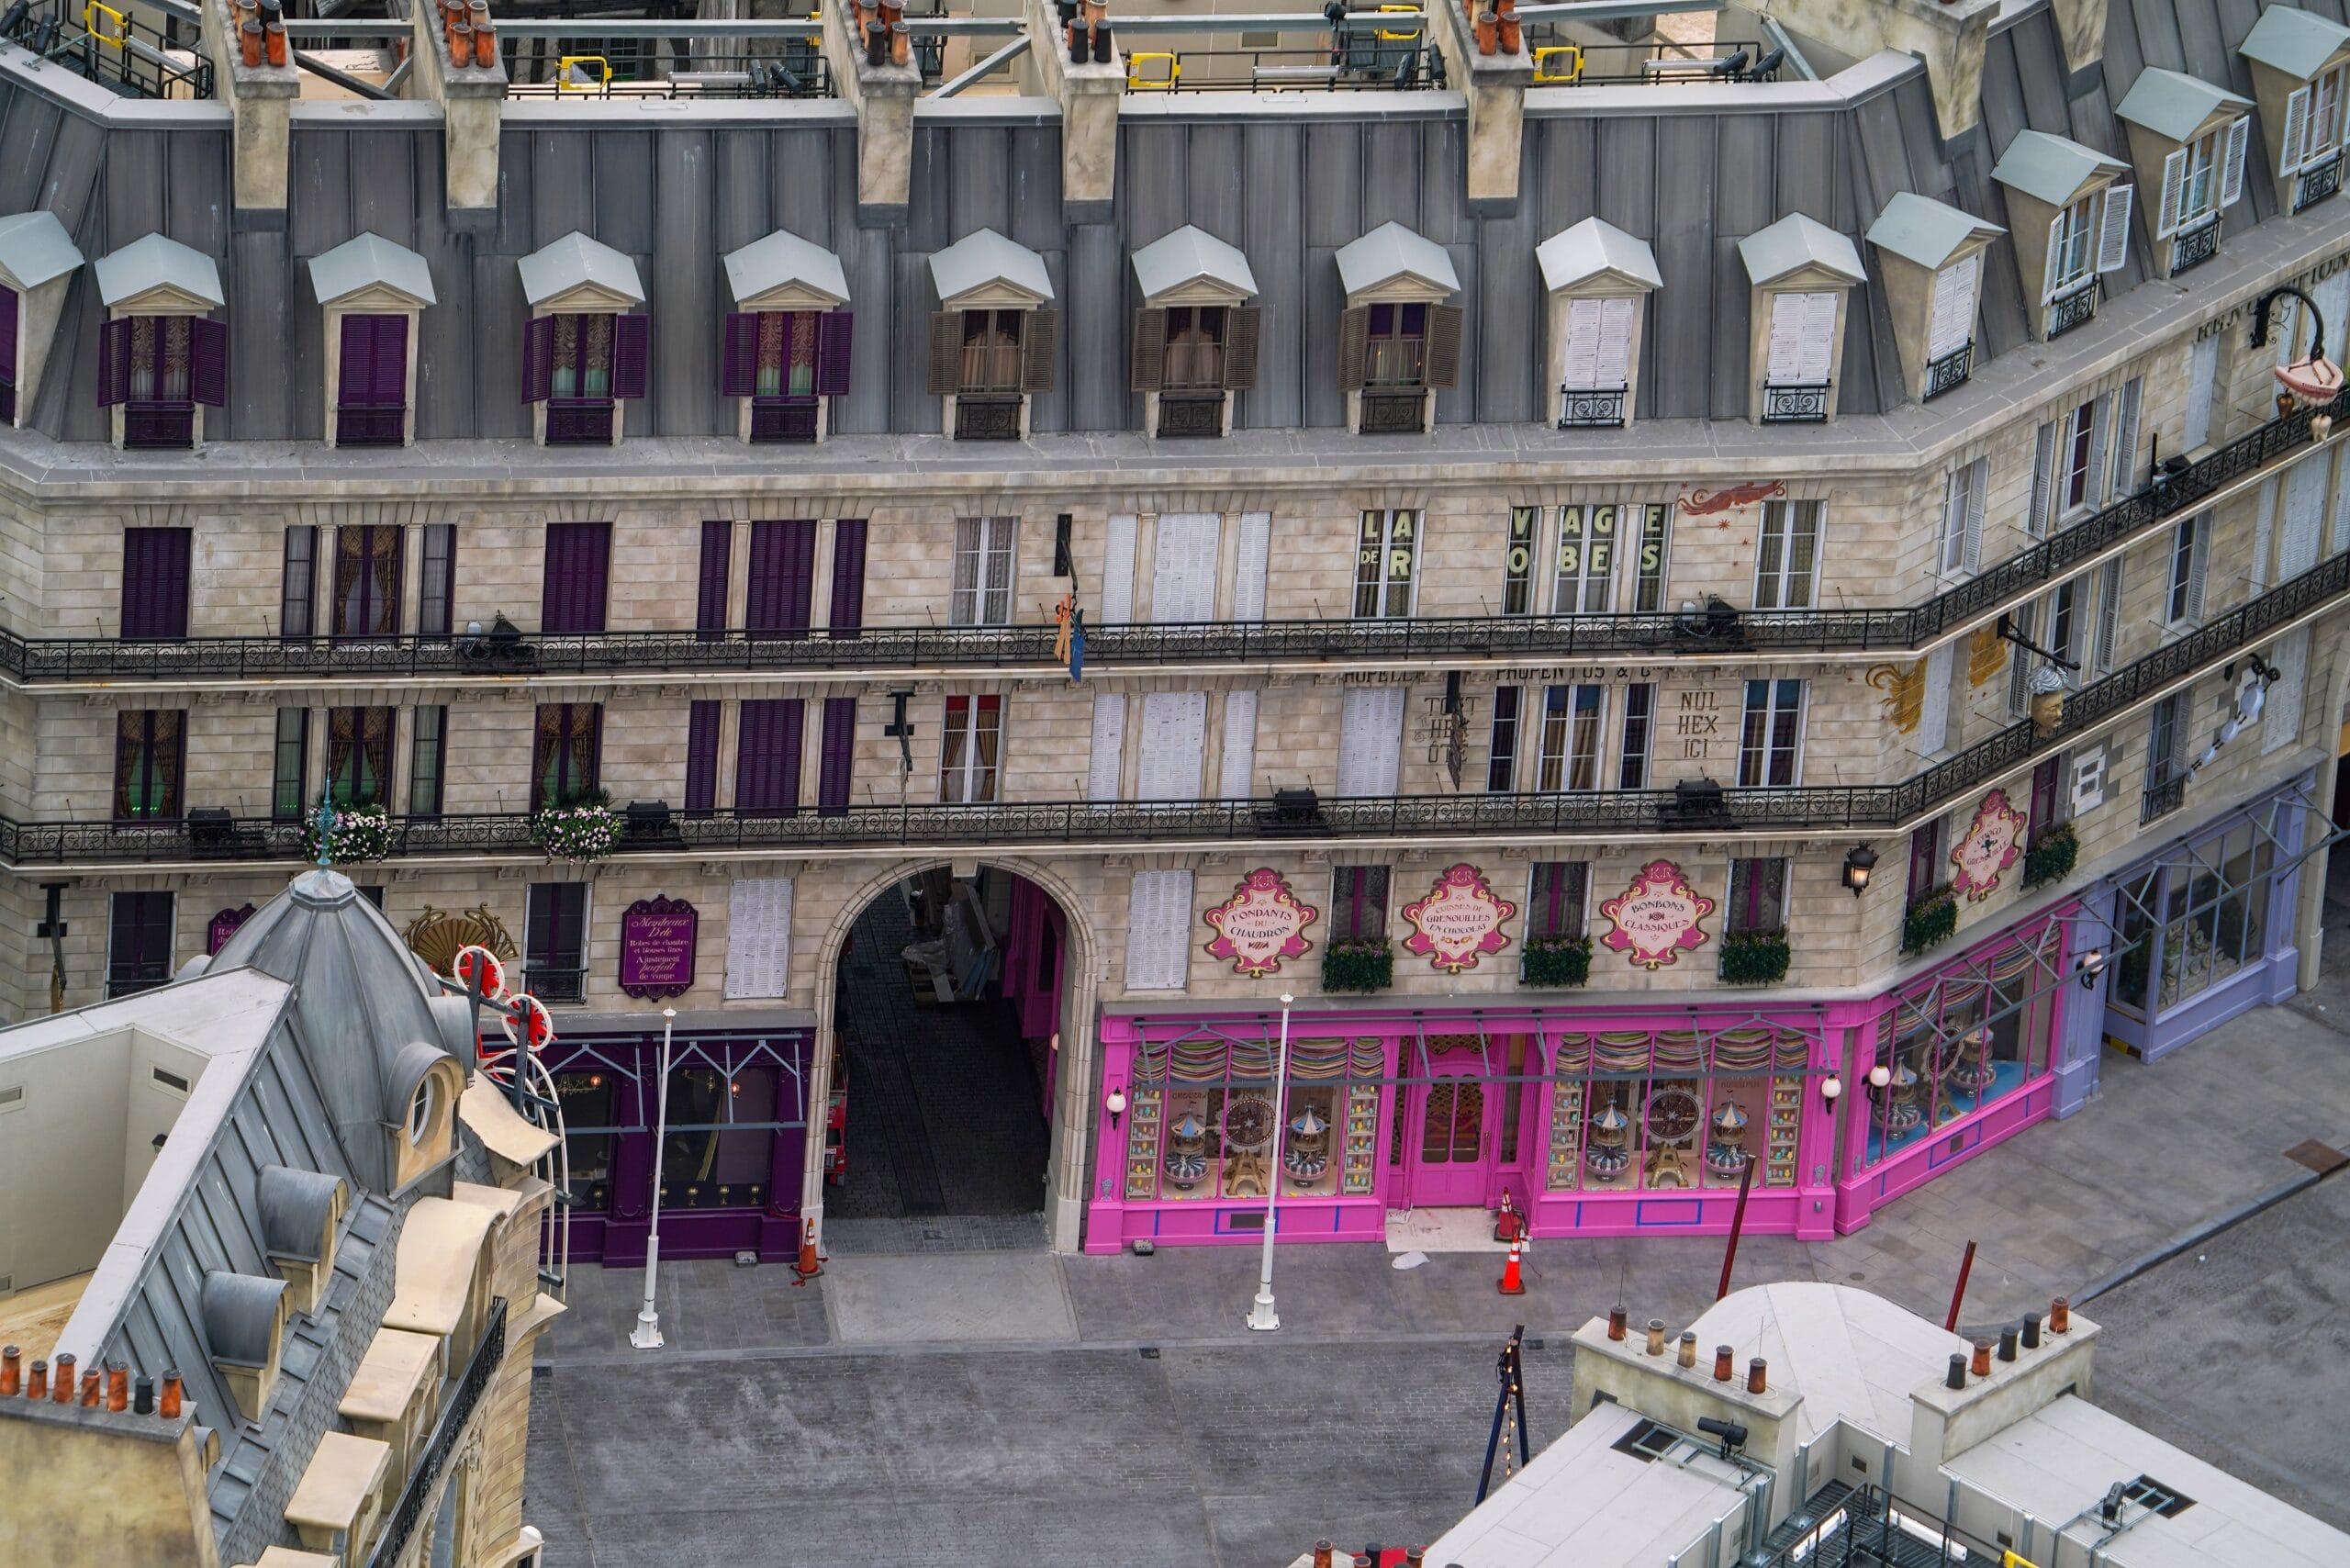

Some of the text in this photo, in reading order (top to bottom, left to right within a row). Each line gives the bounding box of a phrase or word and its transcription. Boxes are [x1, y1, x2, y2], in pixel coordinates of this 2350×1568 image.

[1360, 551, 1381, 565] DE
[1681, 691, 1719, 711] NUL
[1677, 715, 1719, 734] HEX
[1684, 738, 1708, 758] ICI
[1631, 900, 1684, 913] BONBONS
[1232, 909, 1292, 923] FONDANTS
[1427, 914, 1491, 923] GRENOUILLES
[1230, 924, 1290, 938] CHAUDRON
[1443, 924, 1486, 934] CHOCOLAT
[1625, 919, 1690, 932] CLASSIQUES
